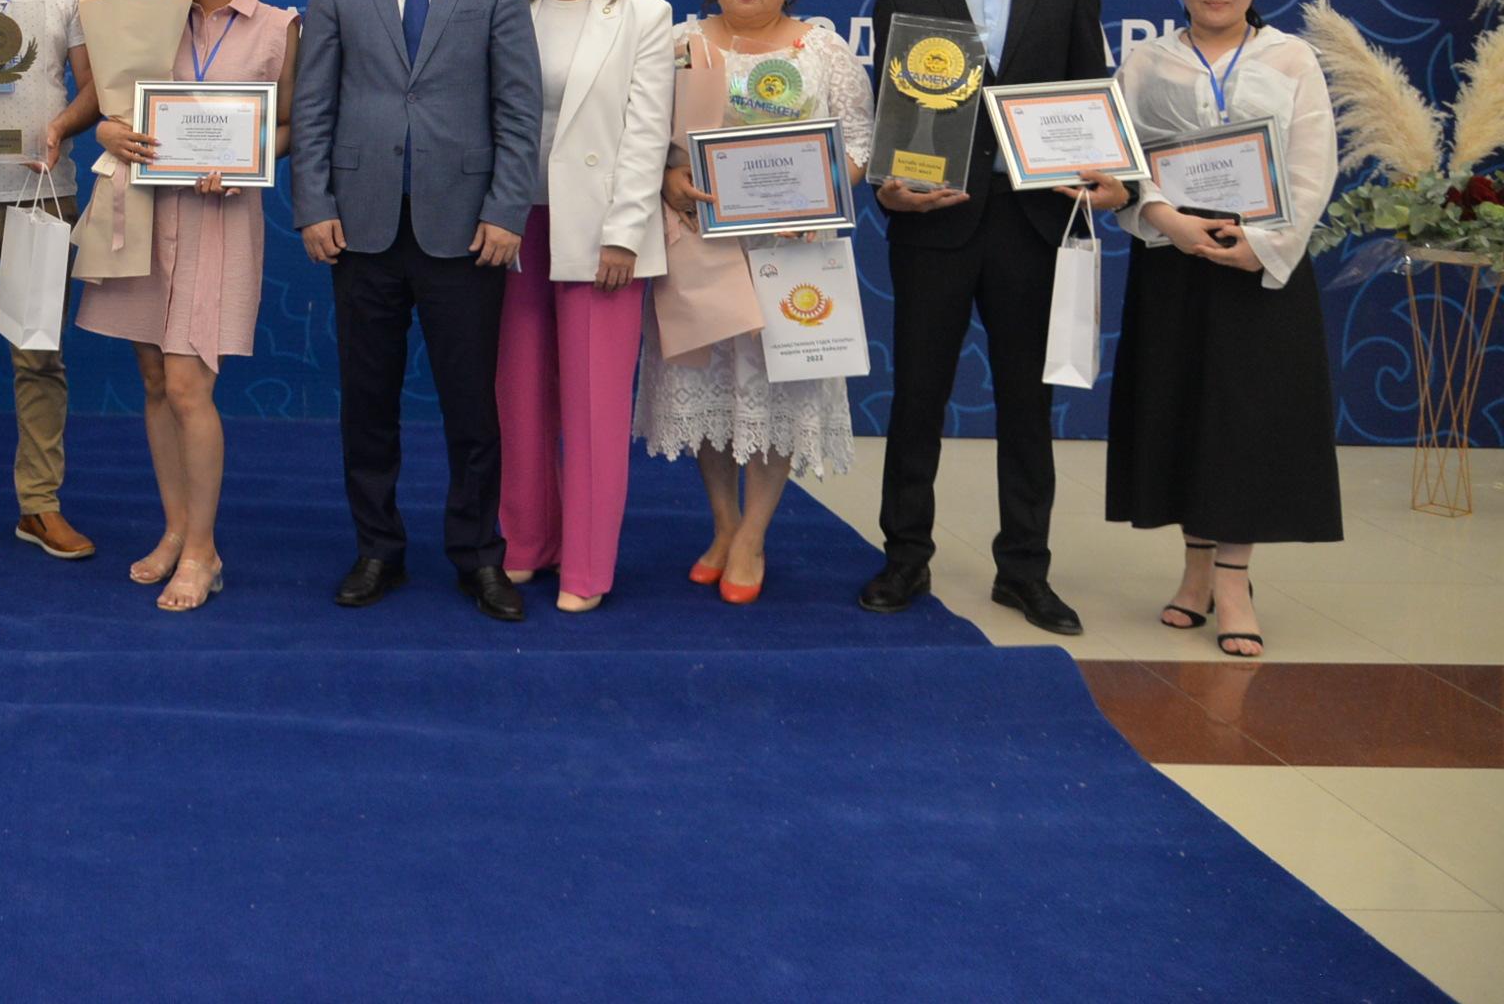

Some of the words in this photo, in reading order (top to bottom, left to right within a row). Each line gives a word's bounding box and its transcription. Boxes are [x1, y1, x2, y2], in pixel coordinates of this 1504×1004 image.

[181, 115, 228, 124] ДИПЛОМ
[1040, 113, 1085, 126] ДИПЛОМ
[743, 156, 794, 171] ДИПЛОМ
[1184, 158, 1234, 176] ДИПЛОМ
